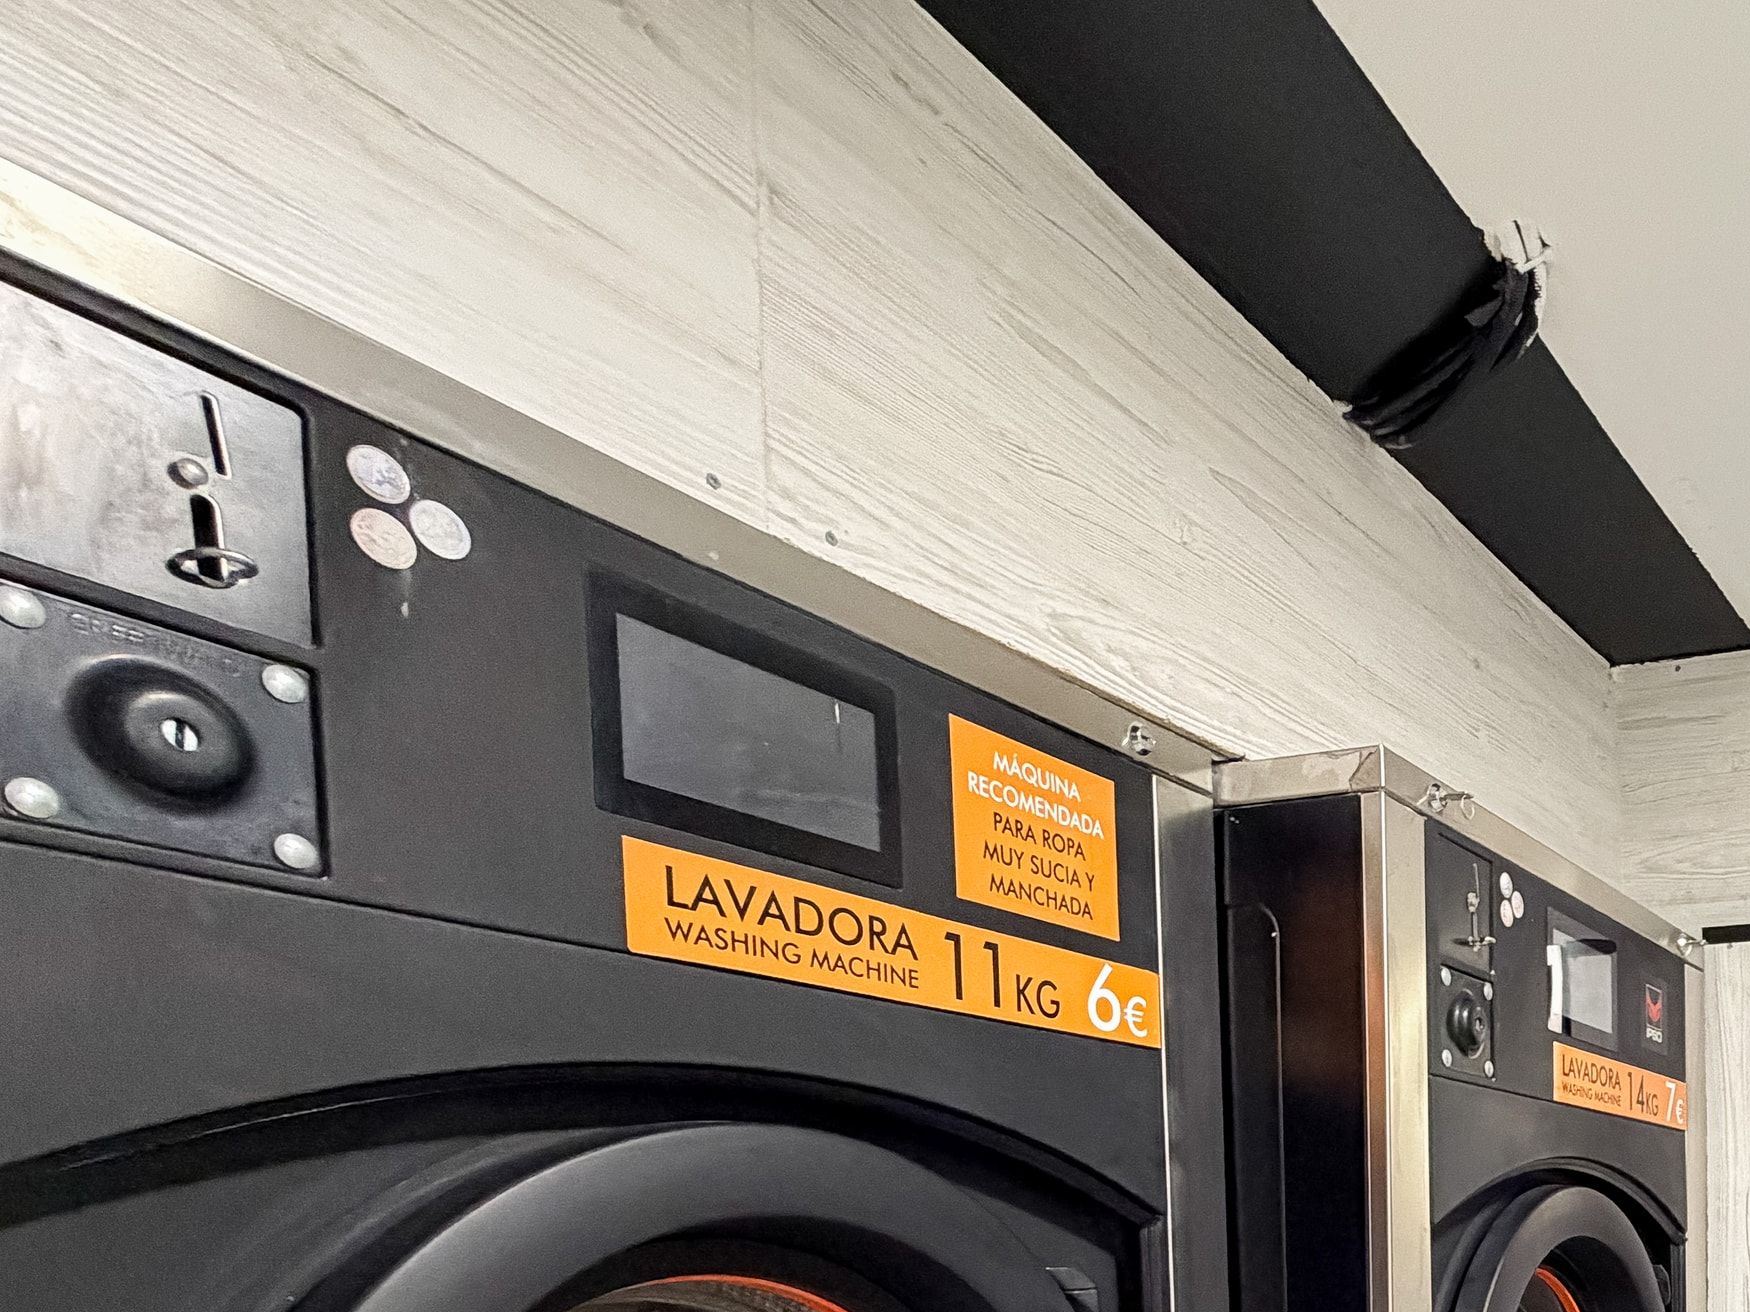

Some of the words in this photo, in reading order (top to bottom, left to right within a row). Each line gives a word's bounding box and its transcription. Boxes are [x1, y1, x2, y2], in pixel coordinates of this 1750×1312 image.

[993, 752, 1081, 802] MÁQUINA
[967, 770, 1104, 839] RECOMENDADA
[993, 812, 1037, 845] PARA
[1042, 829, 1086, 861] ROPA
[983, 840, 1025, 870] MUY
[1030, 855, 1082, 889] SUCIA
[1085, 872, 1095, 893] Y
[665, 864, 919, 961] LAVADORA
[989, 873, 1094, 920] MANCHADA
[664, 917, 802, 965] WASHING
[810, 948, 920, 989] MACHINE
[1562, 1054, 1622, 1091] LAVADORA
